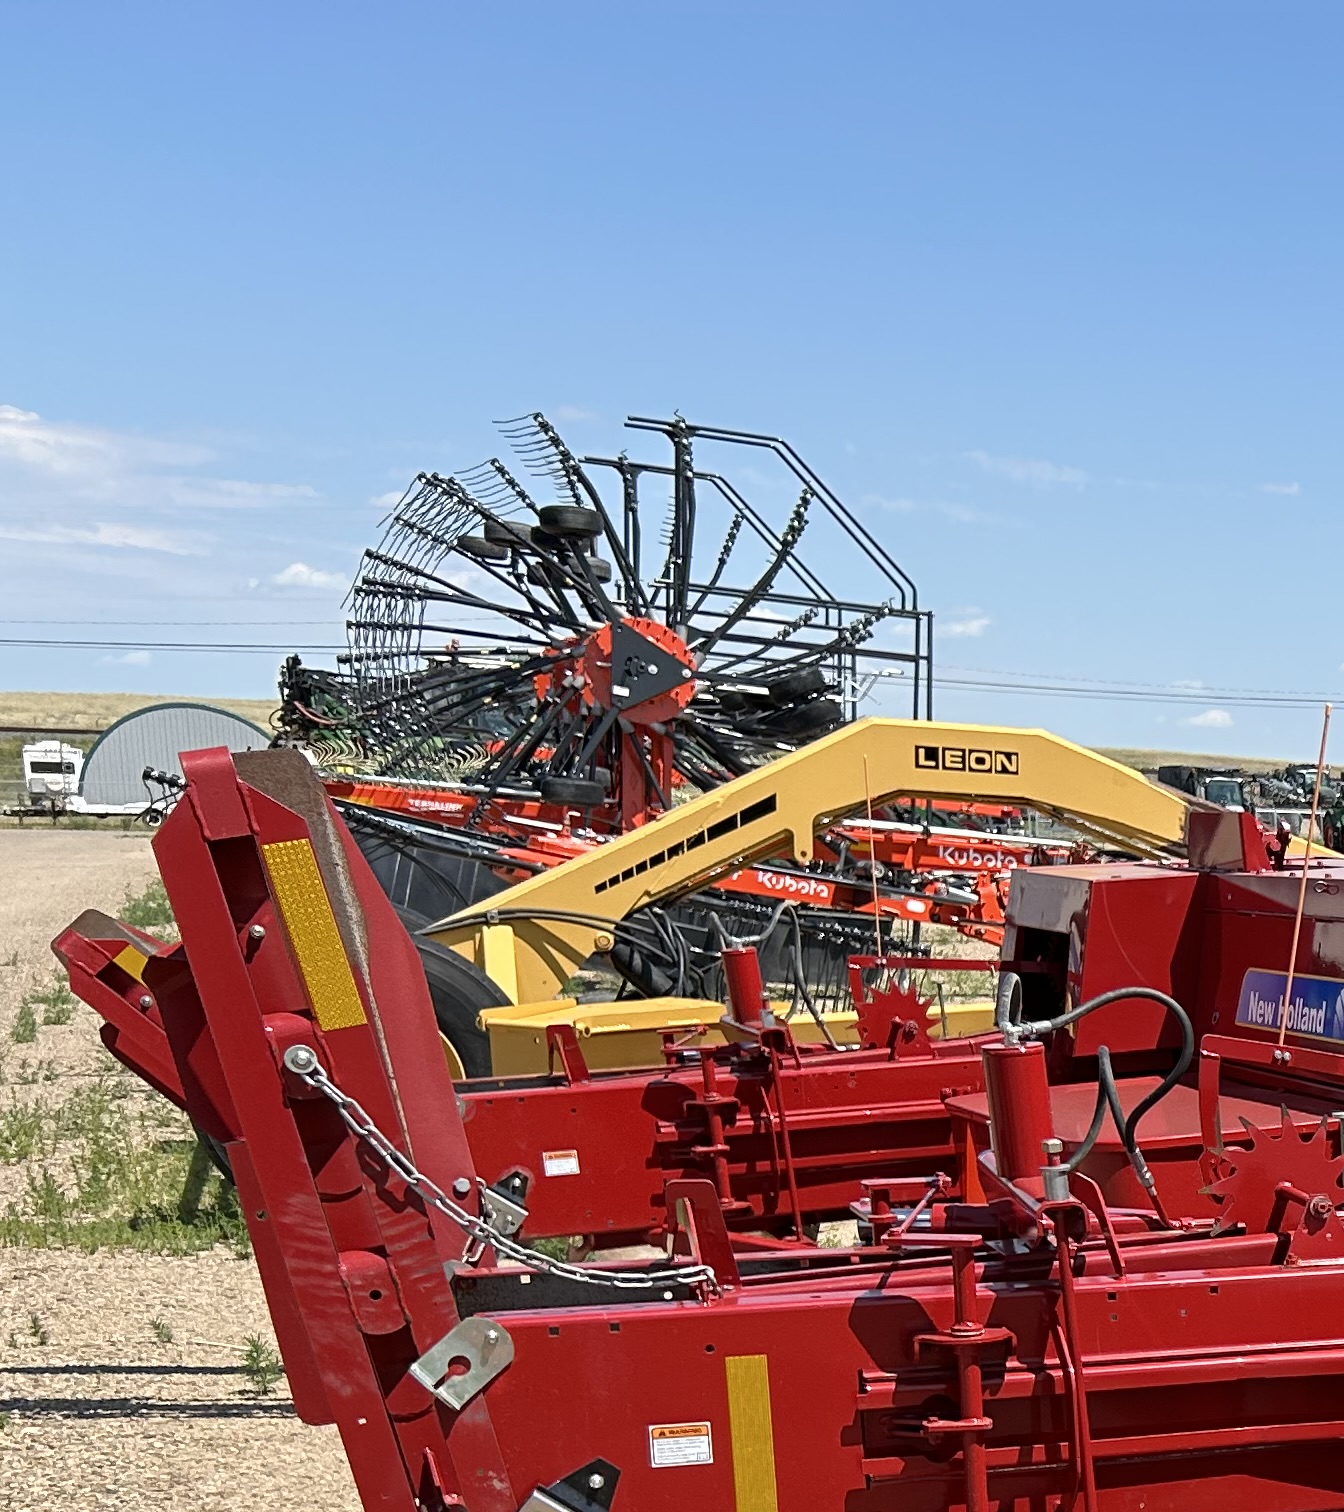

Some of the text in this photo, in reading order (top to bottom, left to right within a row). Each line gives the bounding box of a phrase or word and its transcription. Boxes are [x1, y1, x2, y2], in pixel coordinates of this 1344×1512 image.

[917, 746, 1018, 774] LEON
[938, 845, 1018, 870] Kubota
[757, 870, 830, 898] Kubota
[1248, 990, 1276, 1026] New
